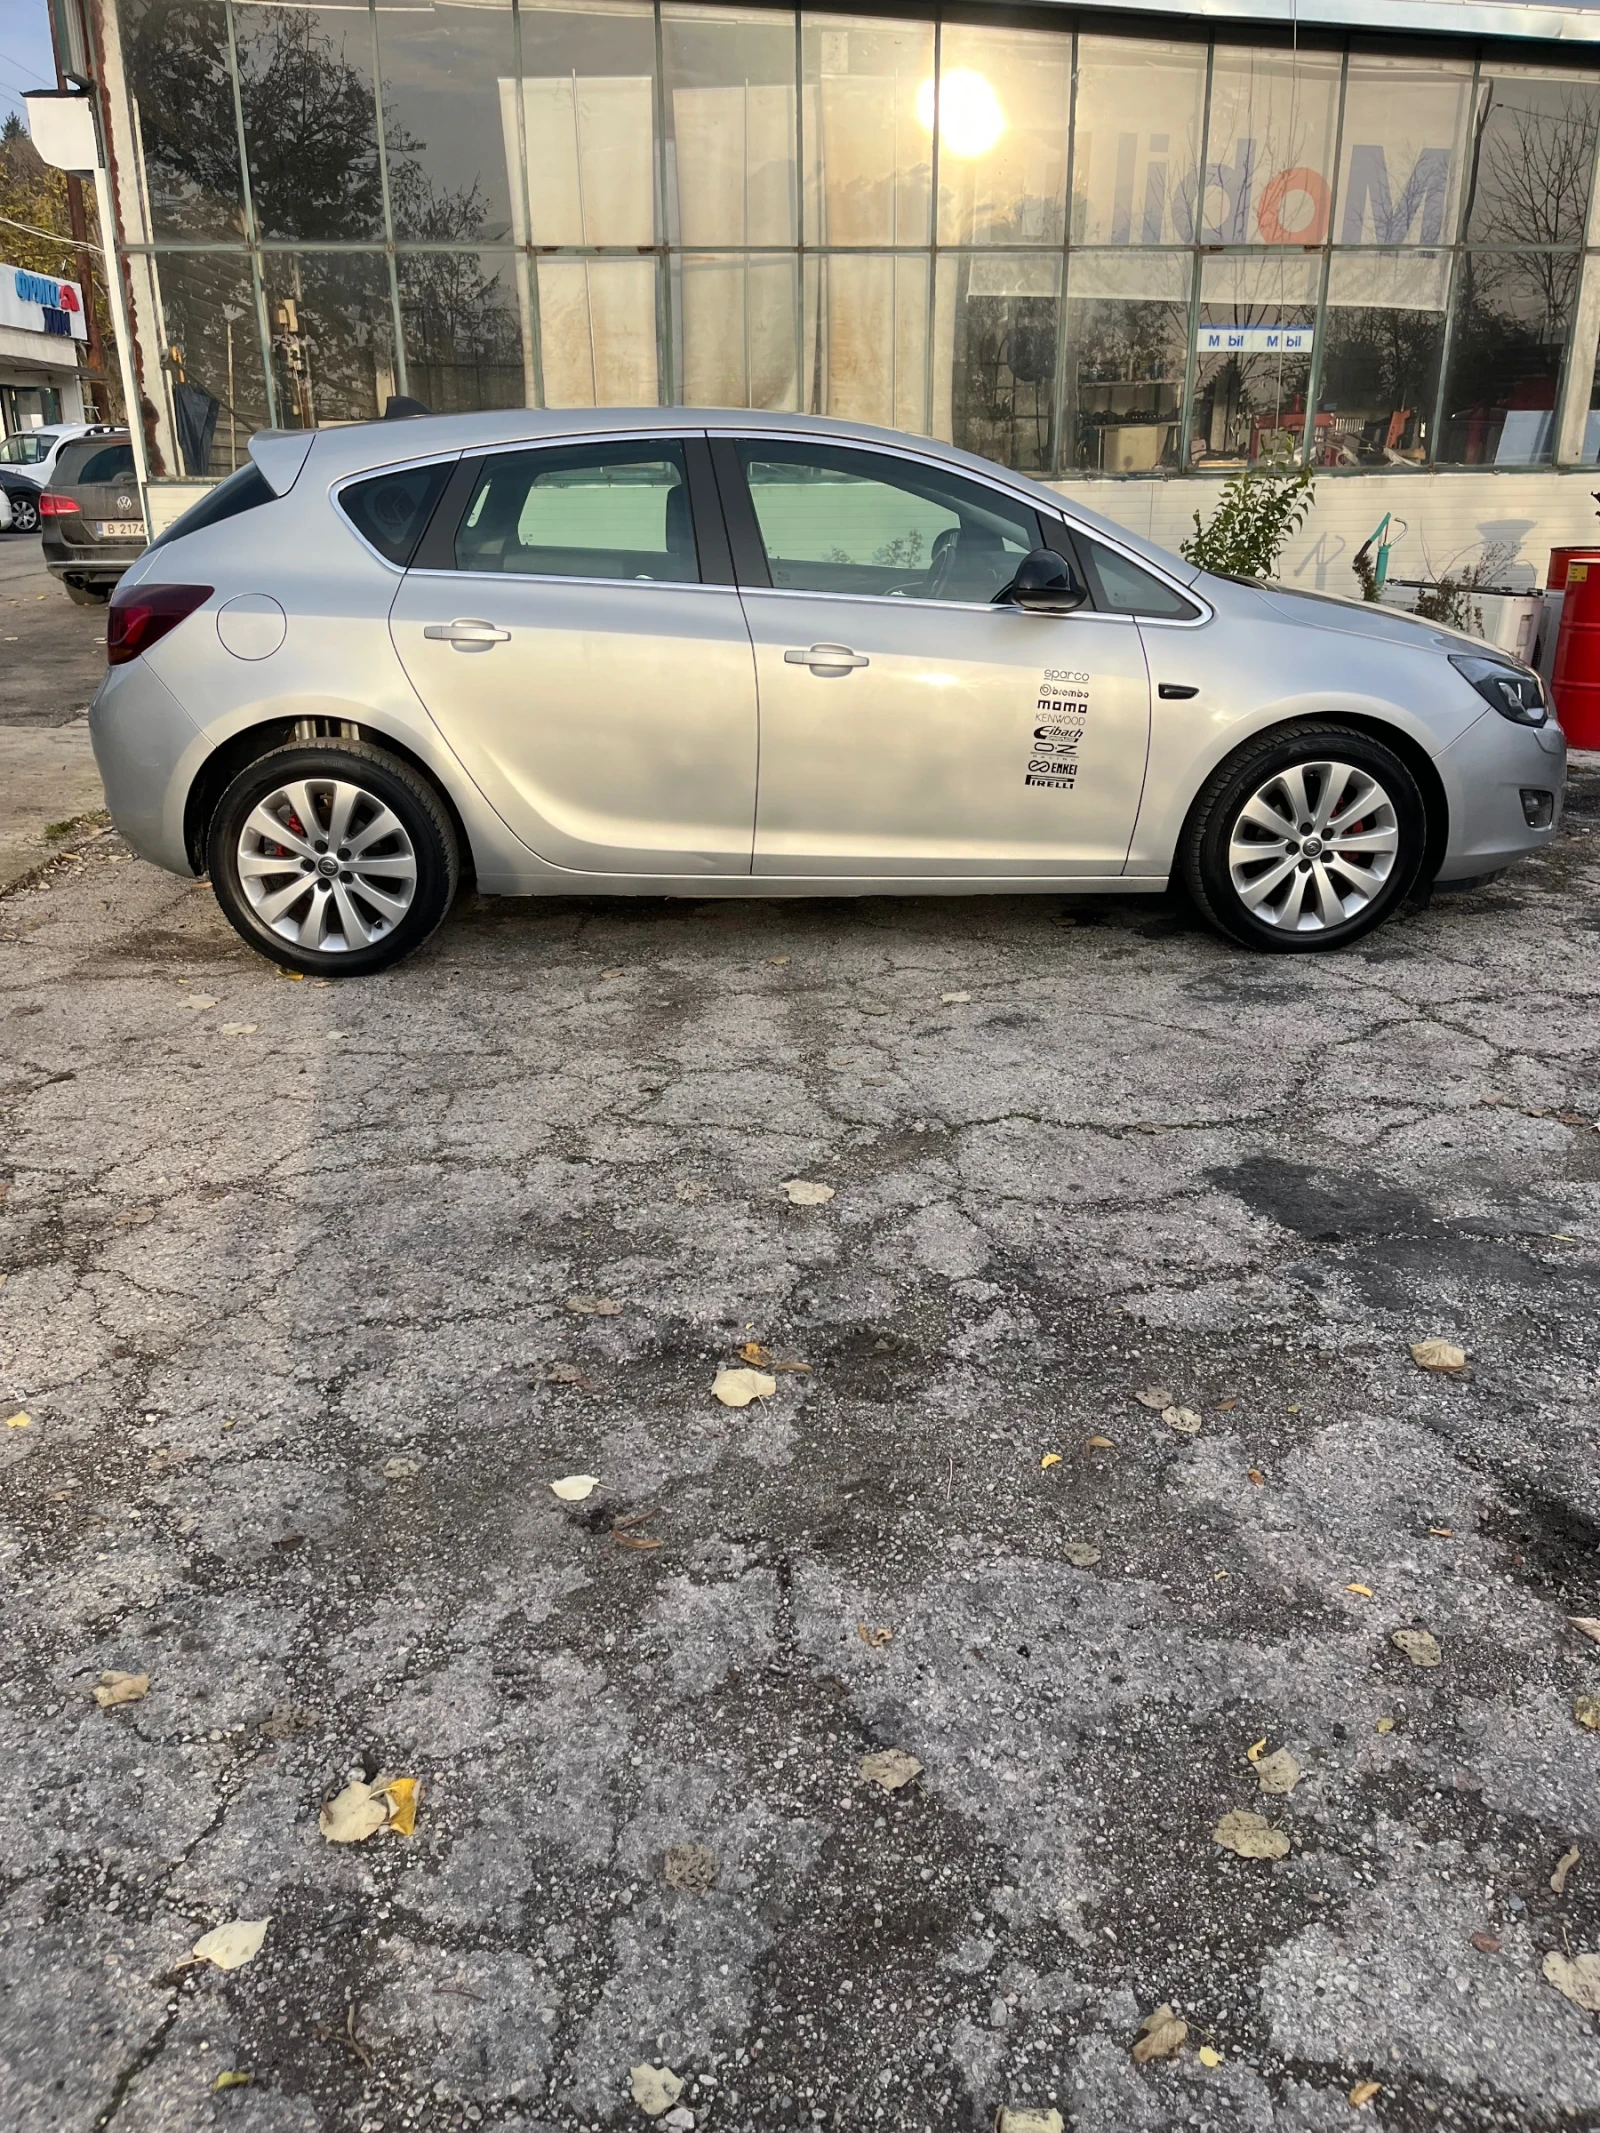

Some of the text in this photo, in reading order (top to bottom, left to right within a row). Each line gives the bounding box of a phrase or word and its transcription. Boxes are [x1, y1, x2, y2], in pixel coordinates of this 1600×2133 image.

[107, 523, 145, 534] B 2174
[1043, 669, 1090, 683] sparco
[1051, 686, 1090, 699] brembo
[1037, 699, 1088, 714] momo
[1035, 713, 1086, 726] KENWOOD
[1033, 725, 1084, 742] Eibach
[1051, 762, 1078, 776] ENKEI
[1025, 774, 1075, 790] PIRELLI
